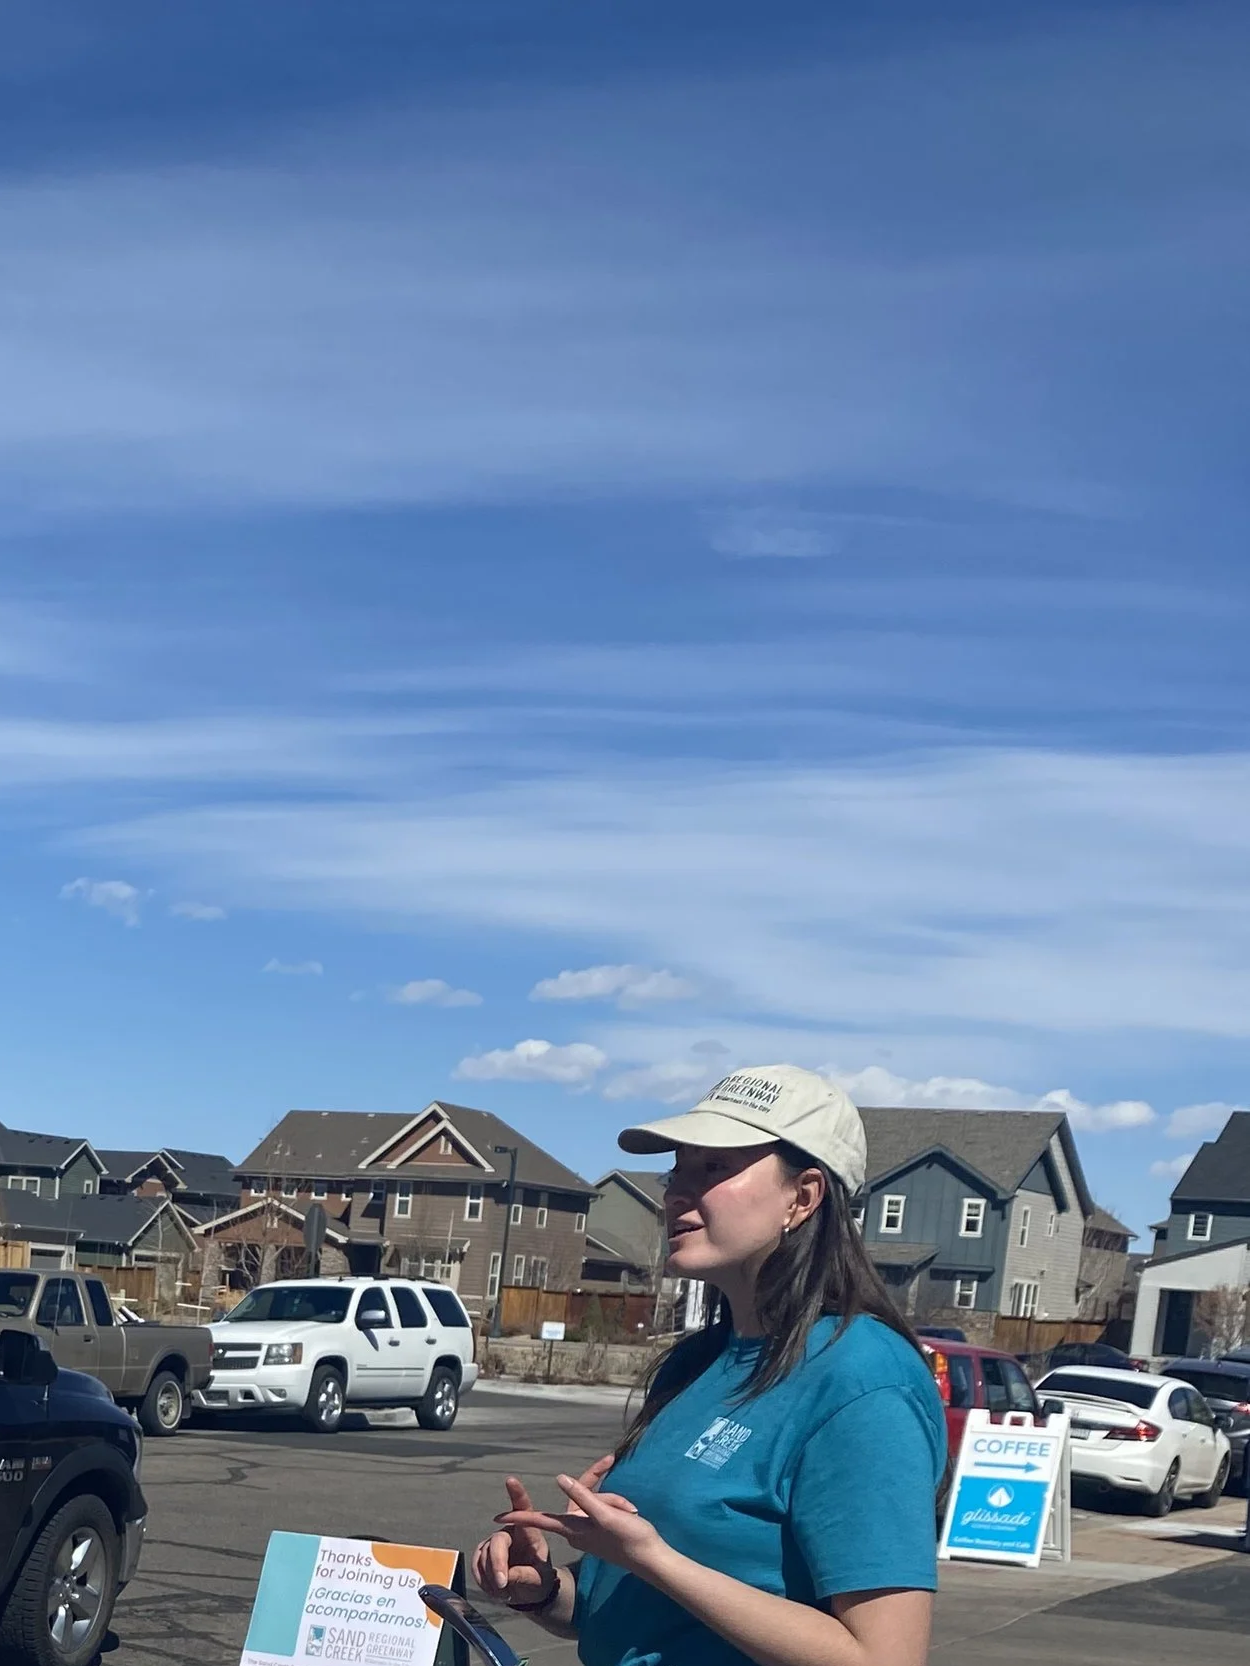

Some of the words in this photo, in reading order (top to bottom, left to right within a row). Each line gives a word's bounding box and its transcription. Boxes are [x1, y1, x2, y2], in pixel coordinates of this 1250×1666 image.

[722, 1084, 779, 1104] GREENWAY
[723, 1421, 751, 1442] SAND
[974, 1439, 1049, 1456] COFFEE
[320, 1549, 372, 1566] Thanks
[315, 1564, 334, 1577] for
[338, 1567, 393, 1589] Joining
[398, 1575, 421, 1589] Us!
[309, 1587, 371, 1606] ¡Gracias
[376, 1596, 395, 1607] en
[306, 1603, 428, 1629] acompañarnos!
[327, 1627, 365, 1647] SAND
[368, 1632, 416, 1649] REGIONAL
[325, 1644, 362, 1661] CREEK
[366, 1644, 415, 1659] GREENWAY
